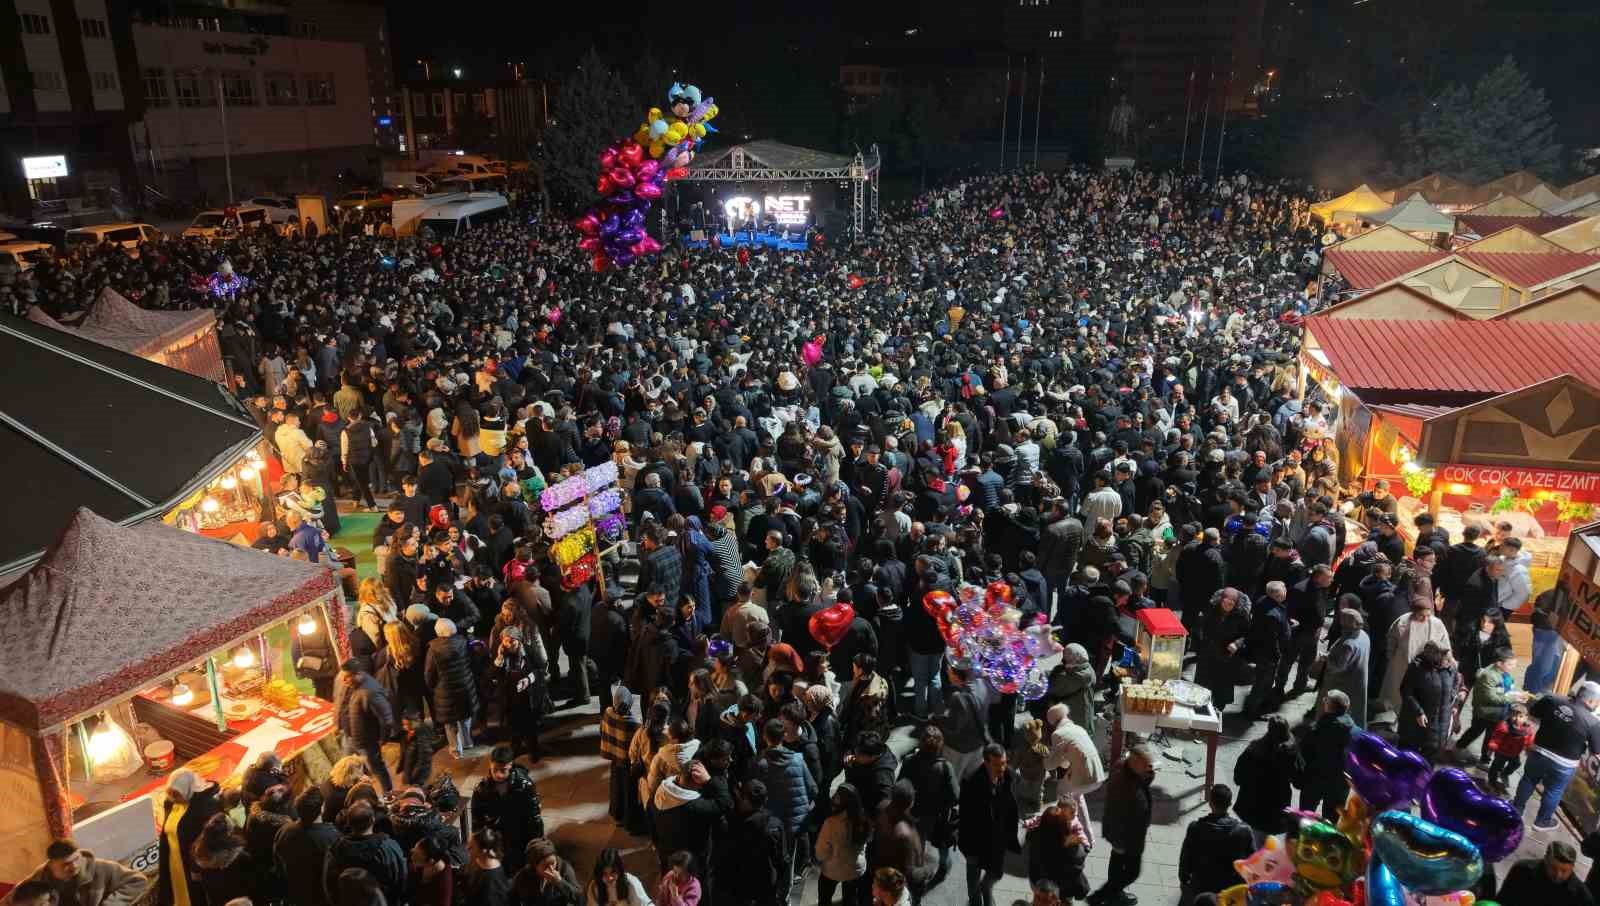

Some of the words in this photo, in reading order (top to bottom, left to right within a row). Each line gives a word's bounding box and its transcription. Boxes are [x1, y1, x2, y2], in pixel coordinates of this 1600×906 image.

[765, 196, 811, 211] NET
[1479, 469, 1511, 485] ÇOK
[1516, 471, 1555, 487] TAZE
